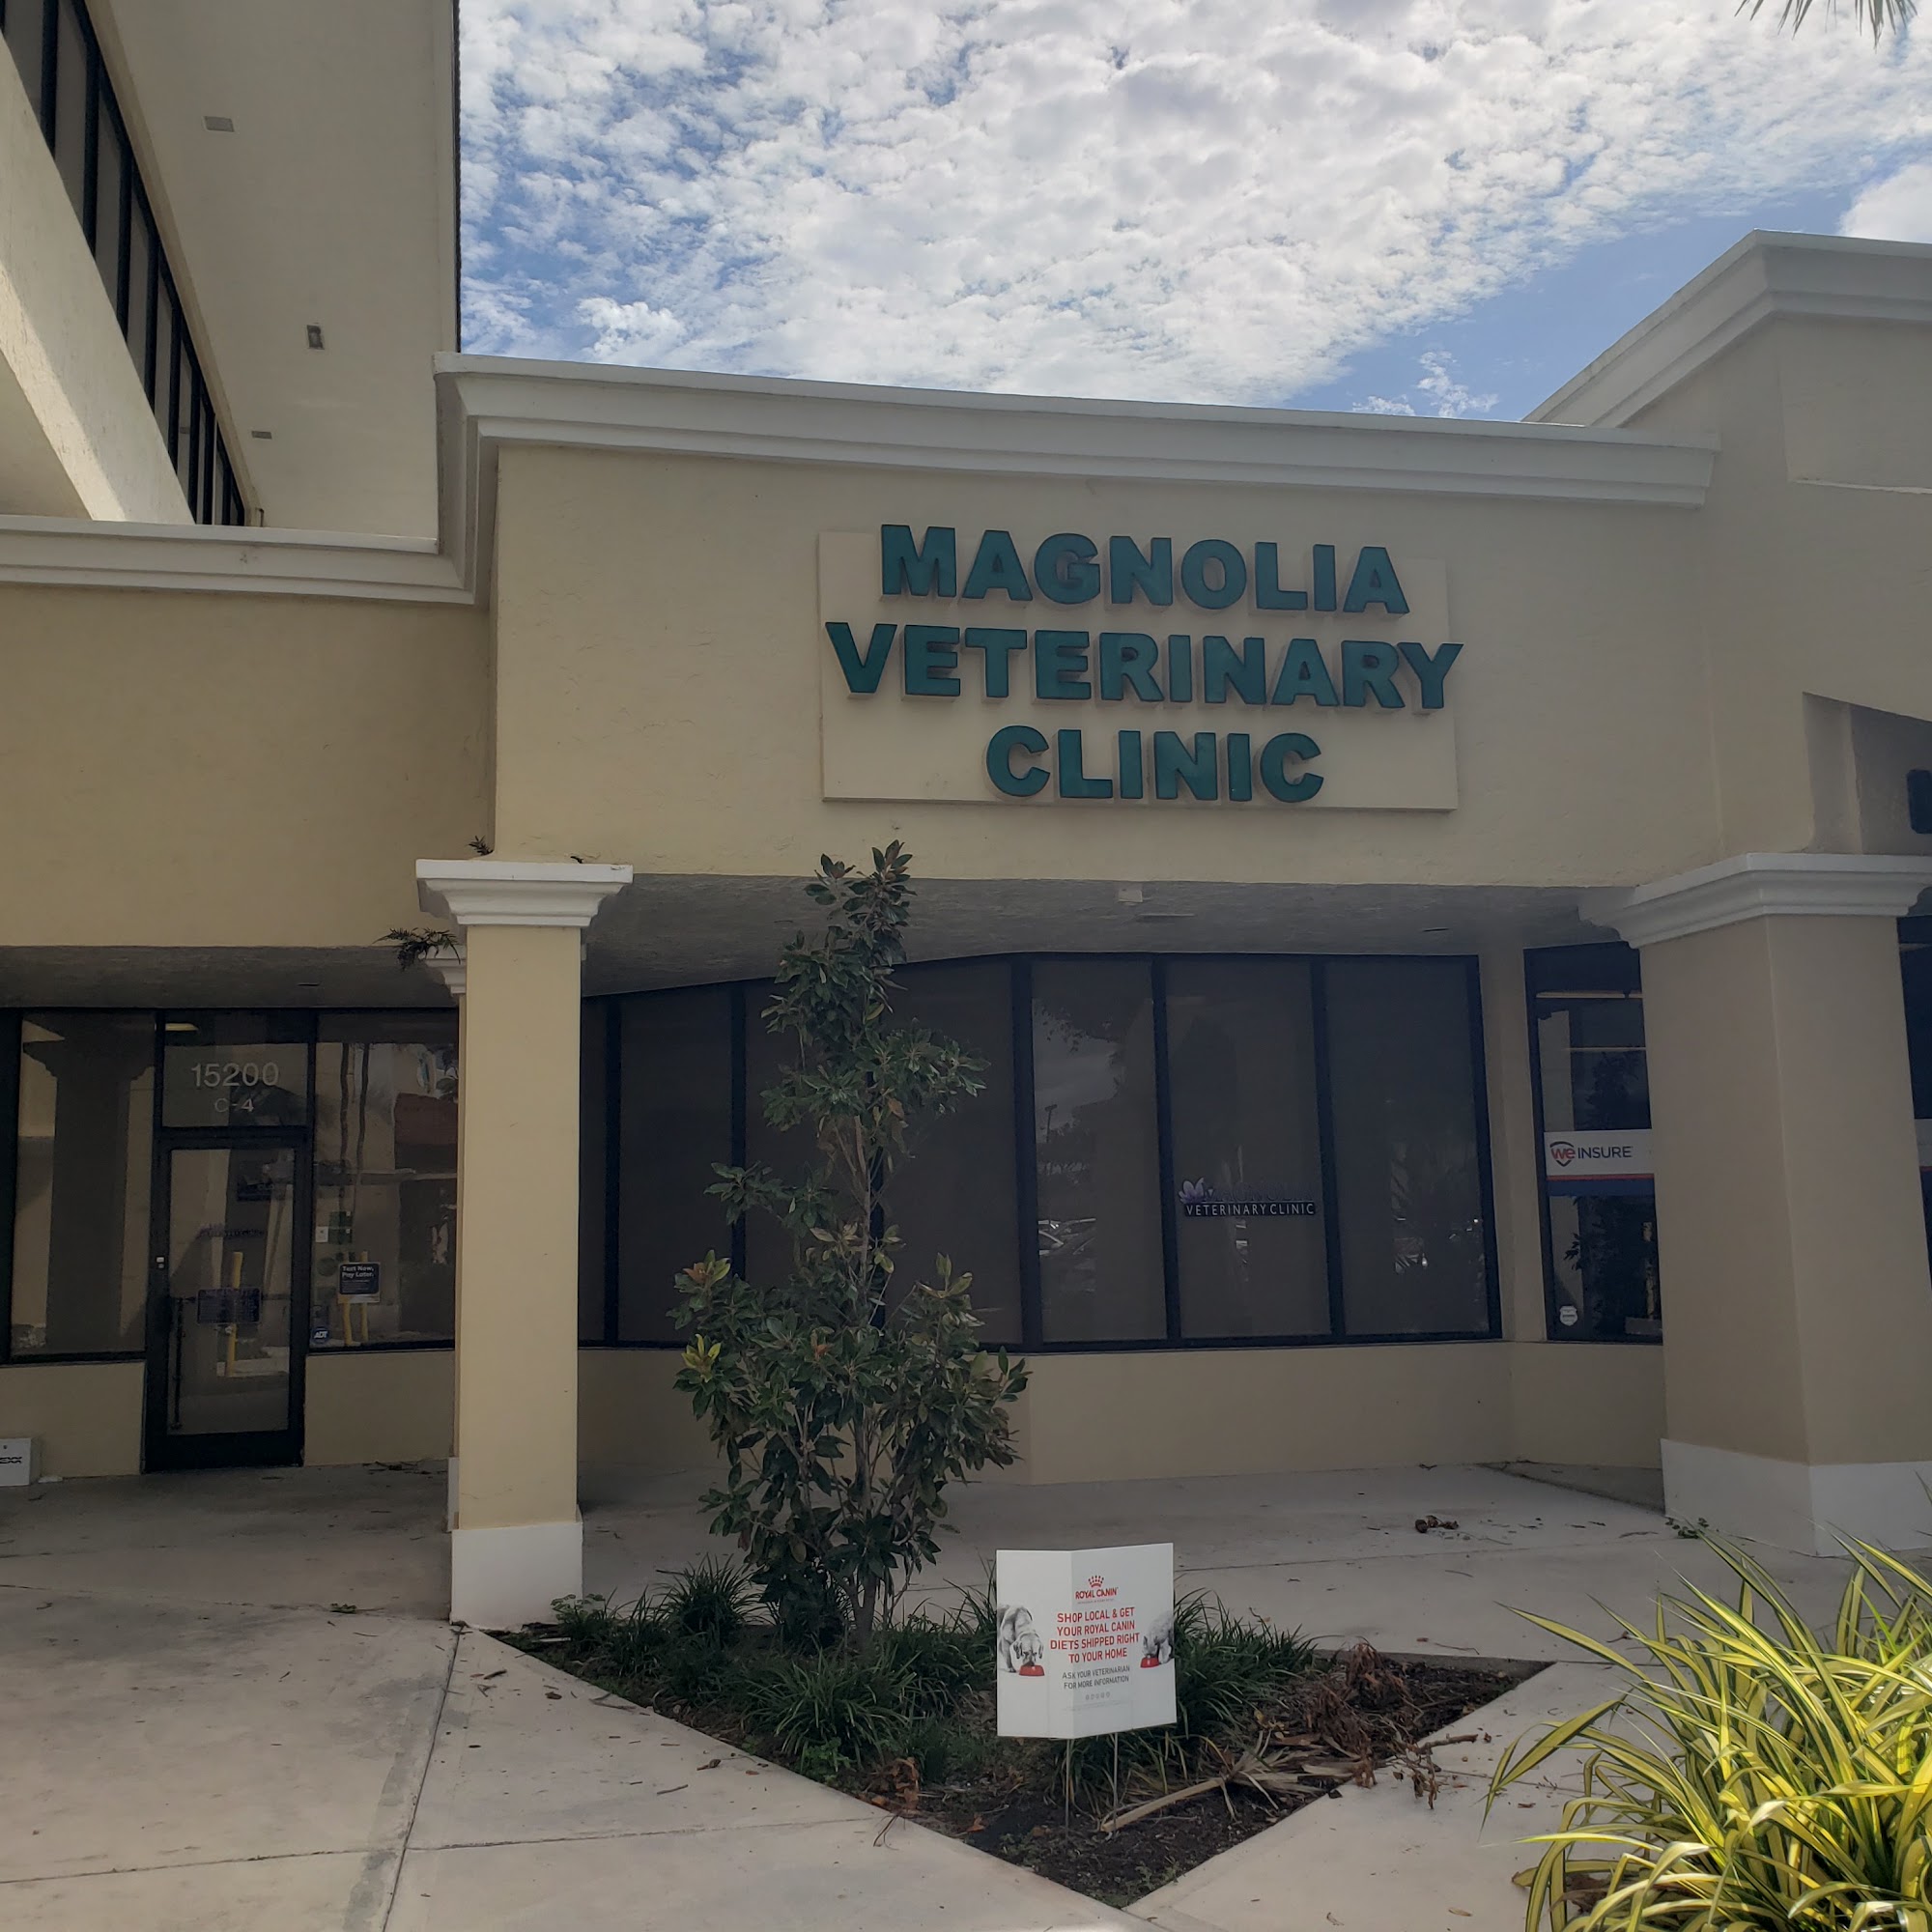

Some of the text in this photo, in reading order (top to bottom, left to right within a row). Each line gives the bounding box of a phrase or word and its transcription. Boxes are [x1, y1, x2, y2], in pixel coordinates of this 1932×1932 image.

[880, 524, 1410, 615] MAGNOLIA
[825, 621, 1464, 710] VETERINARY
[986, 724, 1324, 803] CLINIC
[190, 1061, 279, 1087] 15200
[214, 1097, 254, 1113] C-4
[1577, 1146, 1632, 1159] INSURE
[1186, 1203, 1314, 1215] VETERINARY CLINIC
[1075, 1587, 1118, 1600] ROYAL CANIN
[1057, 1606, 1135, 1623] SHOP LOCAL & GET
[1057, 1620, 1135, 1636] YOUR ROYAL CANIN
[1050, 1633, 1140, 1650] DIETS SHIPPED RIGHT
[1068, 1647, 1127, 1663] TO YOUR HOME
[1077, 1669, 1091, 1678] YOUR
[1092, 1664, 1130, 1677] VETERINARIAN
[1064, 1675, 1129, 1690] FOR MORE INFORMATION
